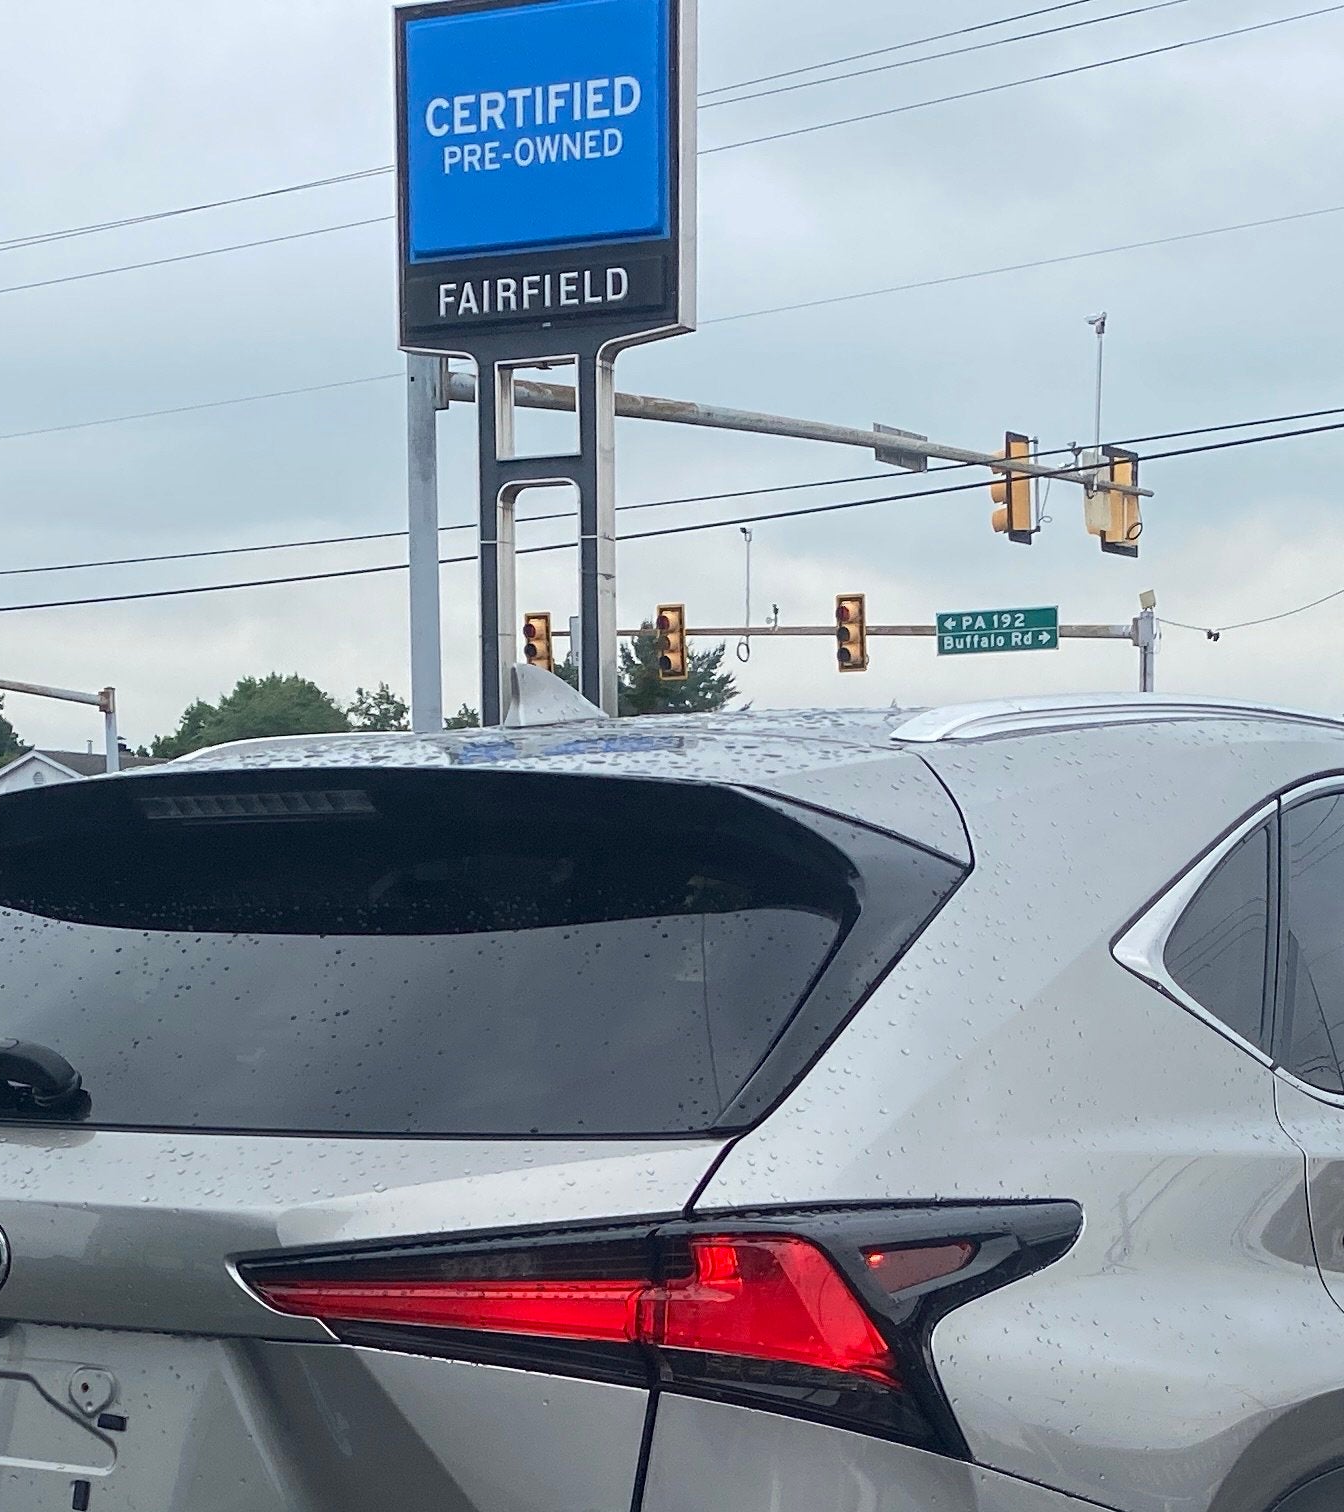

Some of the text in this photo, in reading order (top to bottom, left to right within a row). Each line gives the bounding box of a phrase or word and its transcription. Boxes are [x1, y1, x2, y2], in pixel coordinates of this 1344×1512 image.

[425, 75, 641, 138] CERTIFIED
[443, 127, 624, 175] PRE-OWNED
[438, 266, 629, 318] FAIRFIELD
[943, 631, 1033, 650] Buffalo Rd
[961, 612, 1025, 630] PA 192
